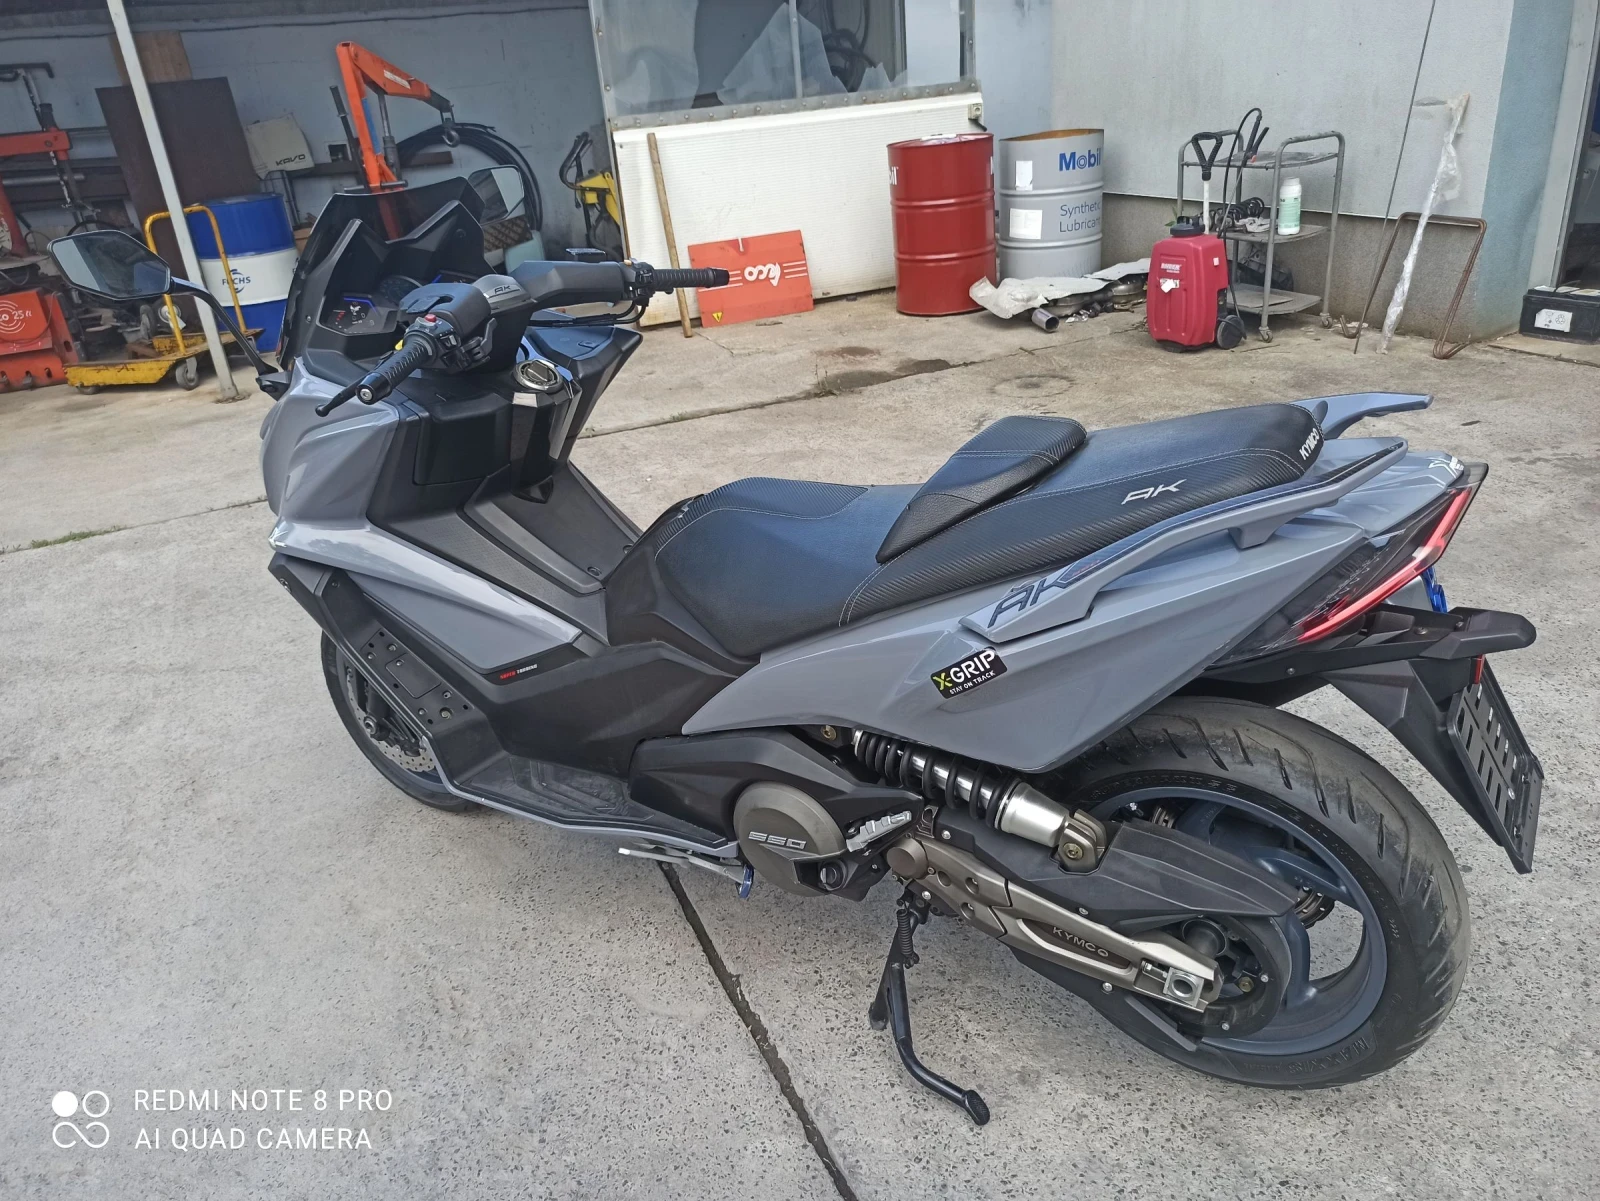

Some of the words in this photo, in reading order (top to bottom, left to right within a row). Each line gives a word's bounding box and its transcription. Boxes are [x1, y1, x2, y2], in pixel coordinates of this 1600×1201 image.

[275, 154, 306, 166] KAVO
[1059, 148, 1101, 171] Mobil
[494, 285, 511, 294] AK
[12, 310, 24, 319] 25
[1299, 427, 1320, 460] KYMCO
[1121, 479, 1187, 505] AK
[987, 578, 1067, 628] AK
[932, 650, 995, 690] X-GRIP
[949, 684, 963, 695] STAY
[964, 681, 973, 689] ON
[973, 670, 996, 684] TRACK
[748, 831, 807, 849] 550
[1053, 926, 1108, 957] KYMCO
